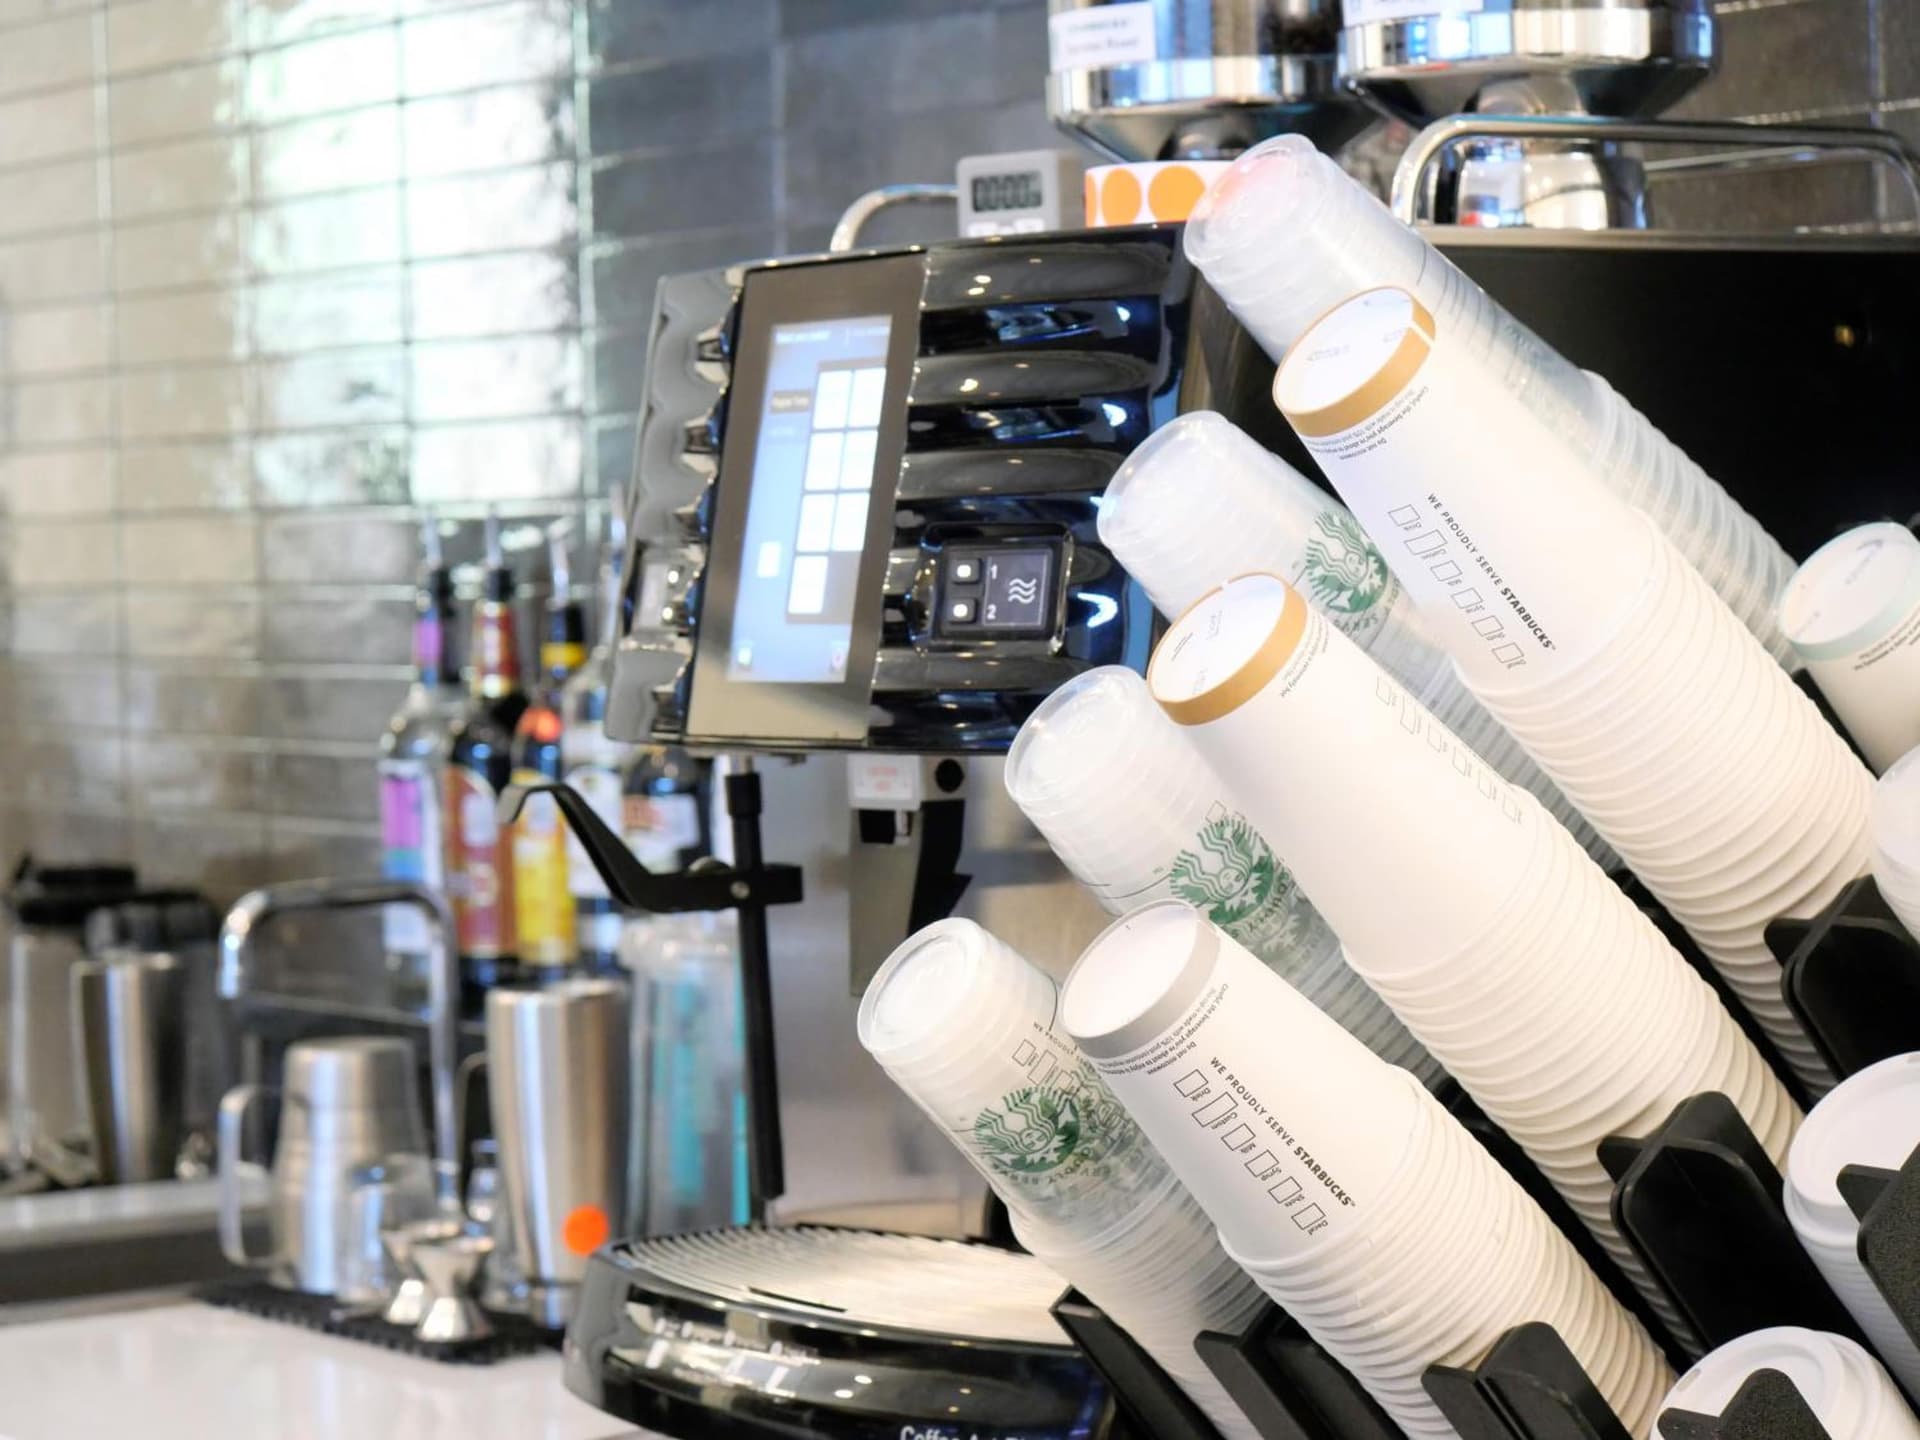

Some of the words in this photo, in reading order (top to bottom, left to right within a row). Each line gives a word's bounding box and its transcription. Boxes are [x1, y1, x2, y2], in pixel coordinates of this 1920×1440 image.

[1428, 493, 1443, 510] WE
[1442, 512, 1478, 554] PROUDLY
[1476, 555, 1501, 585] SERVE
[990, 564, 998, 579] 1
[987, 604, 996, 620] 2
[1176, 1048, 1187, 1058] not
[1210, 1057, 1227, 1074] WE
[1226, 1075, 1268, 1116] PROUDLY
[1265, 1117, 1295, 1146] SERVE
